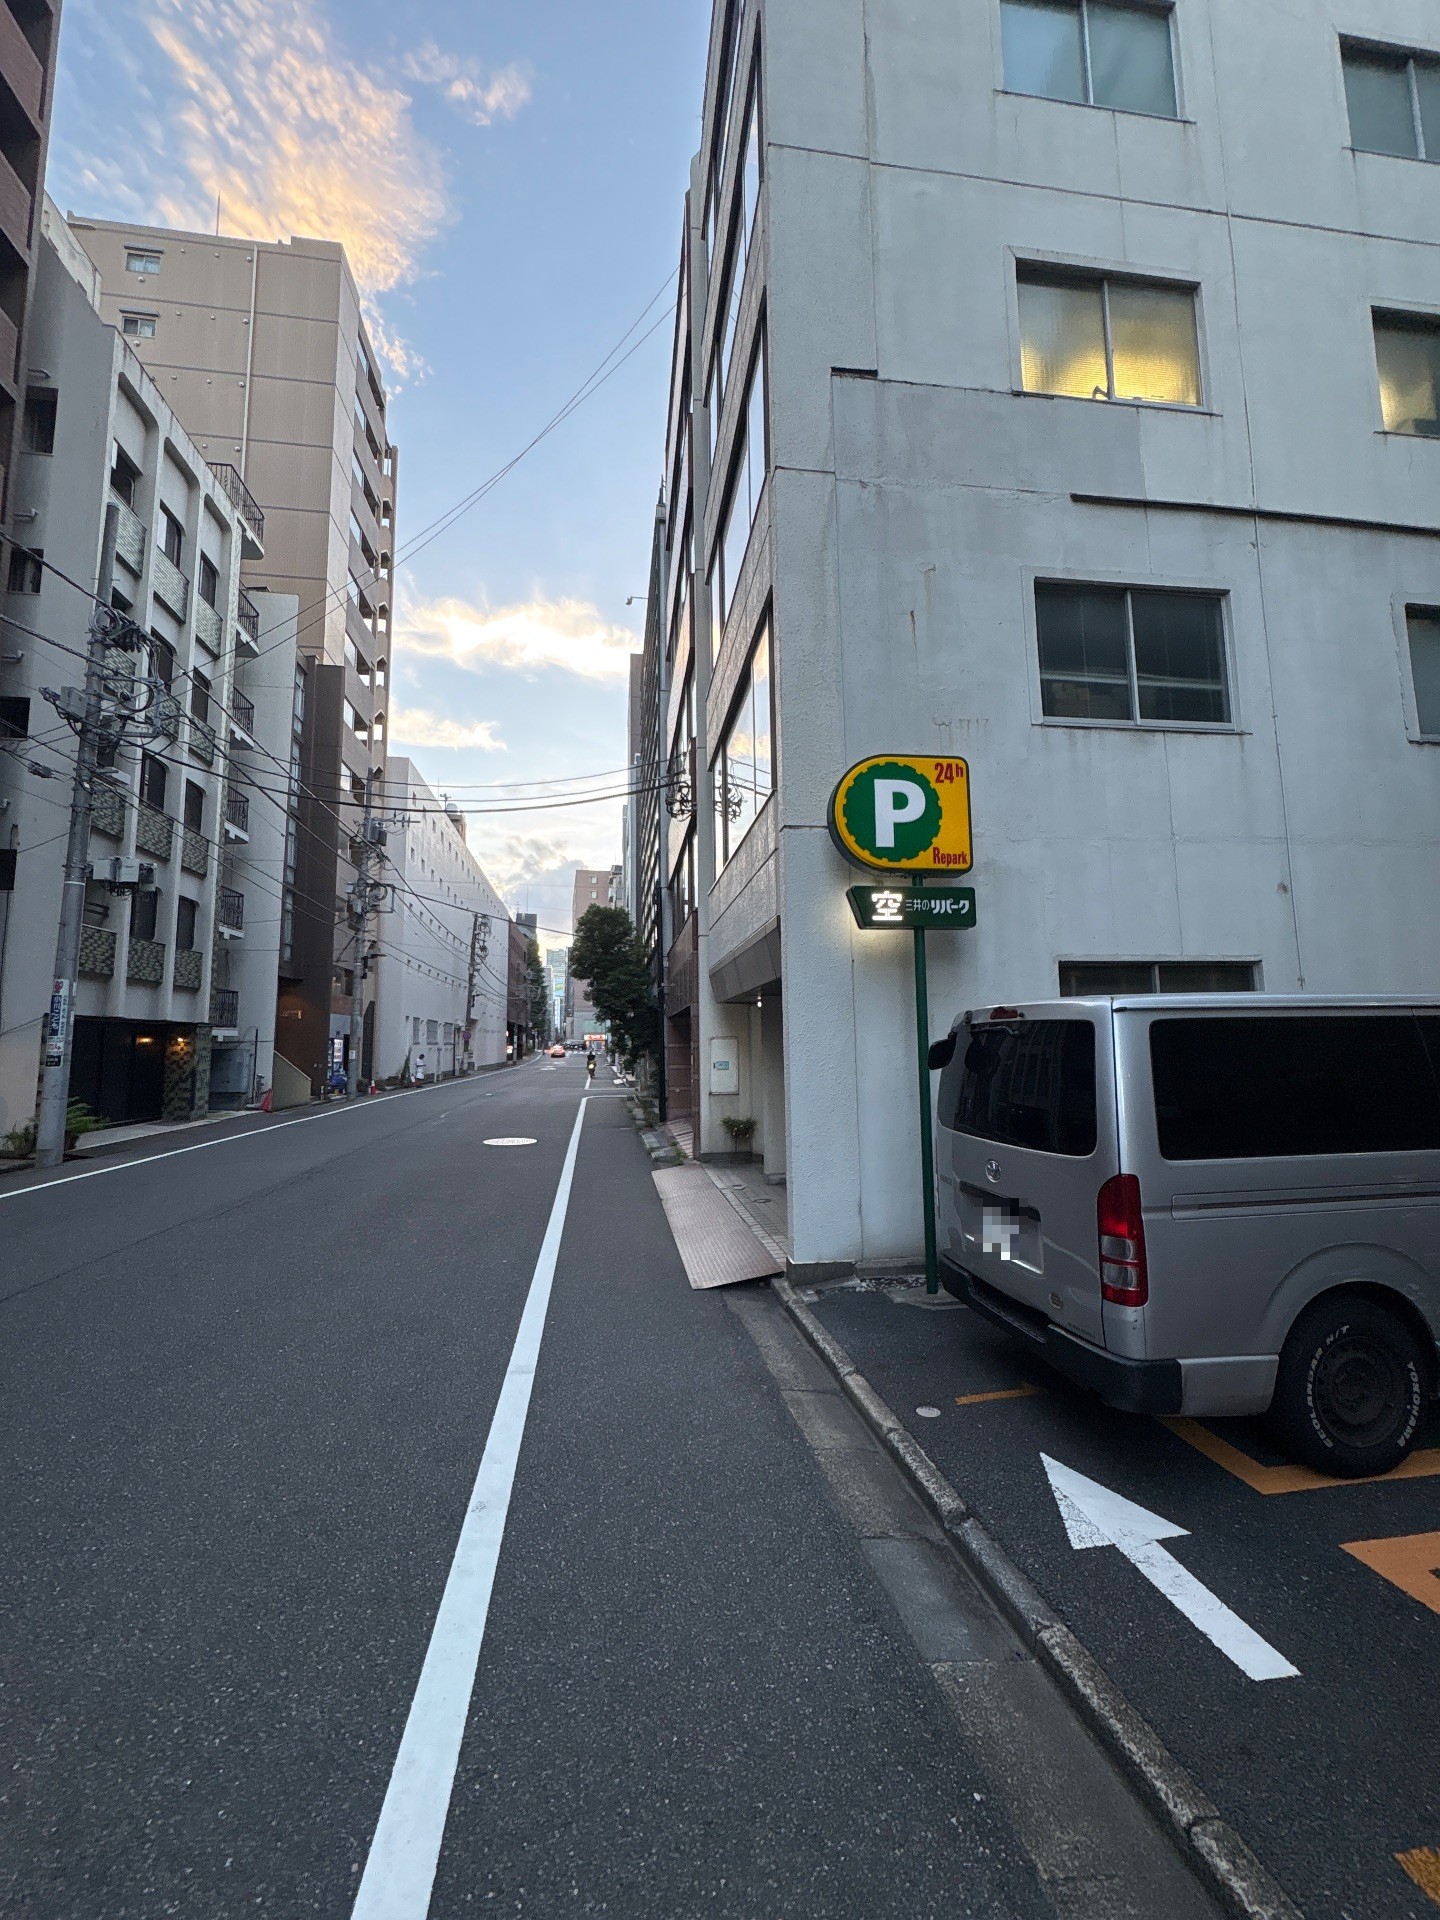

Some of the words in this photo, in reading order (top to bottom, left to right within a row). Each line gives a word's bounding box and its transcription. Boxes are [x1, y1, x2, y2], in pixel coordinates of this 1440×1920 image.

[935, 763, 963, 784] 24h
[874, 779, 926, 848] P
[933, 847, 968, 867] Repark
[871, 890, 903, 921] 空
[905, 898, 970, 914] 三井のリパーク
[1397, 1361, 1421, 1447] YOKOHAMA
